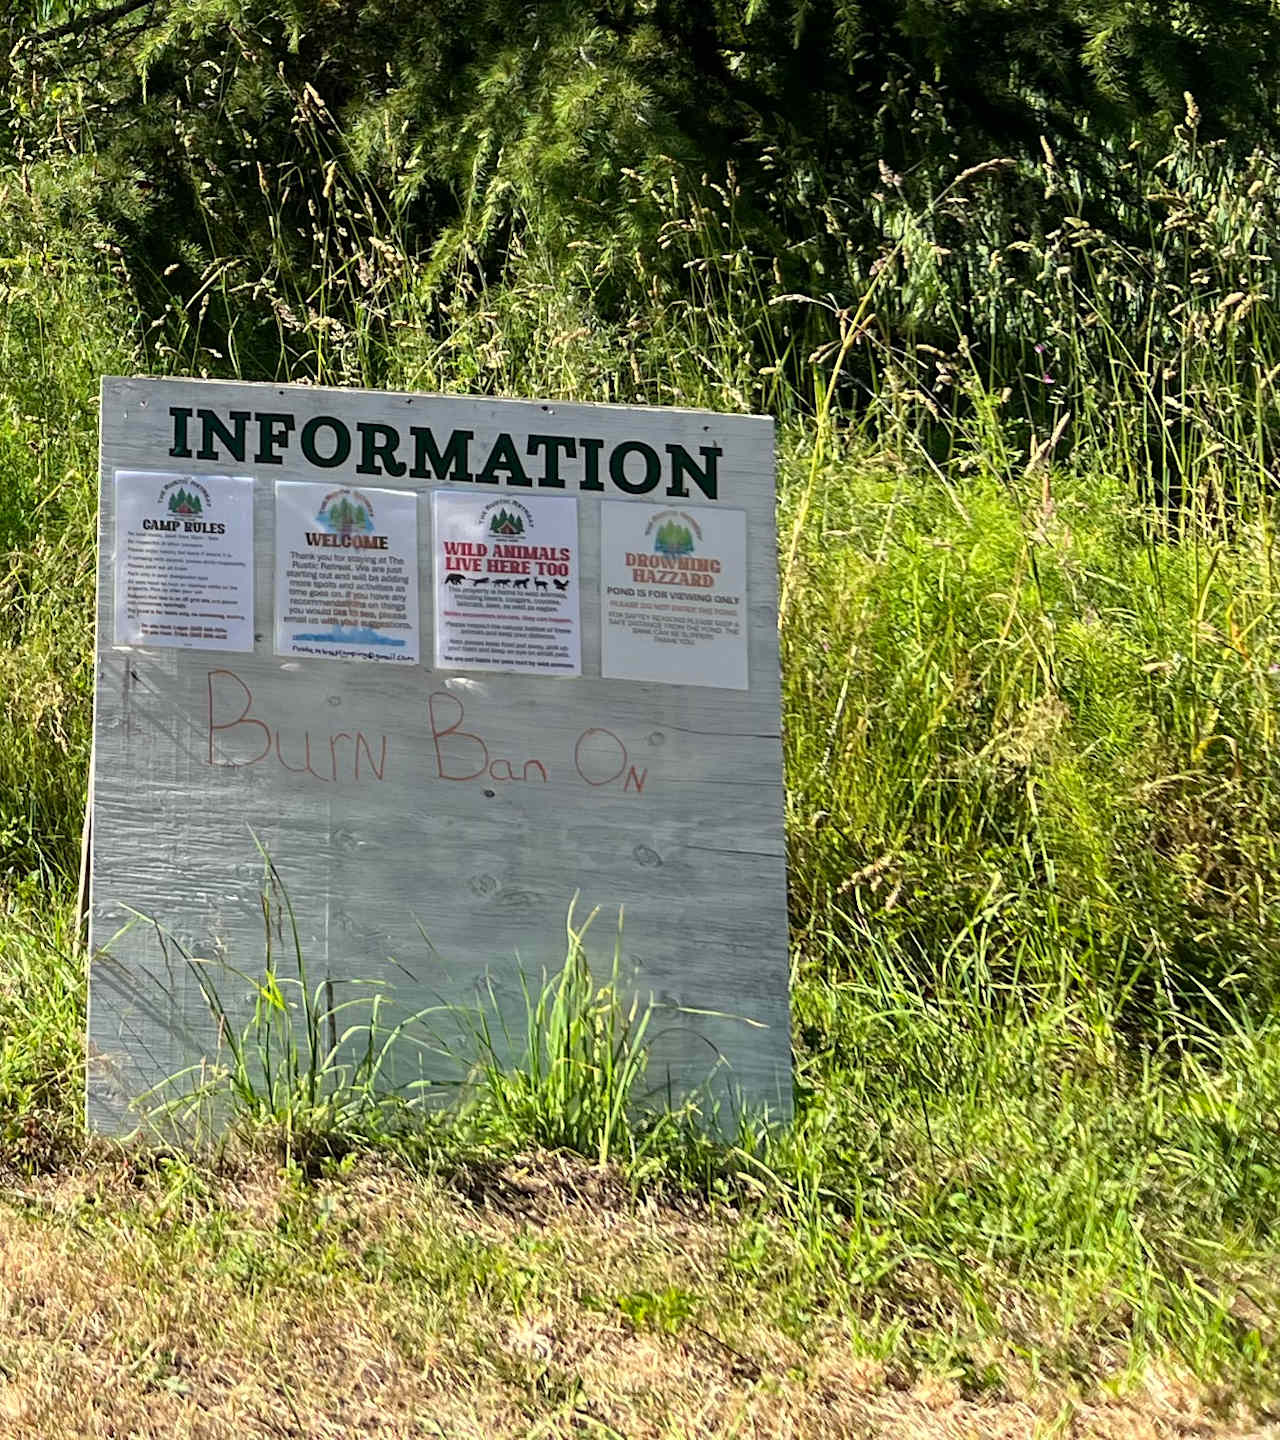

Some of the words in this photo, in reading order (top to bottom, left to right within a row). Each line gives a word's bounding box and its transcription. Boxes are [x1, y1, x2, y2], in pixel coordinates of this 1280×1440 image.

[168, 406, 723, 500] INFORMATION
[142, 519, 181, 532] CAMP
[183, 521, 226, 535] RULES
[305, 532, 389, 550] WELCOME
[443, 541, 488, 557] WILD
[492, 544, 571, 561] ANIMALS
[445, 557, 482, 572] LIVE
[486, 559, 531, 575] HERE
[535, 562, 569, 577] TOO
[625, 552, 721, 573] DROWNING
[632, 568, 714, 588] HAZZARD
[607, 586, 635, 596] POND
[637, 588, 647, 598] IS
[648, 589, 669, 599] FOR
[669, 591, 712, 603] VIEWING
[714, 594, 739, 605] ONLY
[428, 692, 548, 782] Ban
